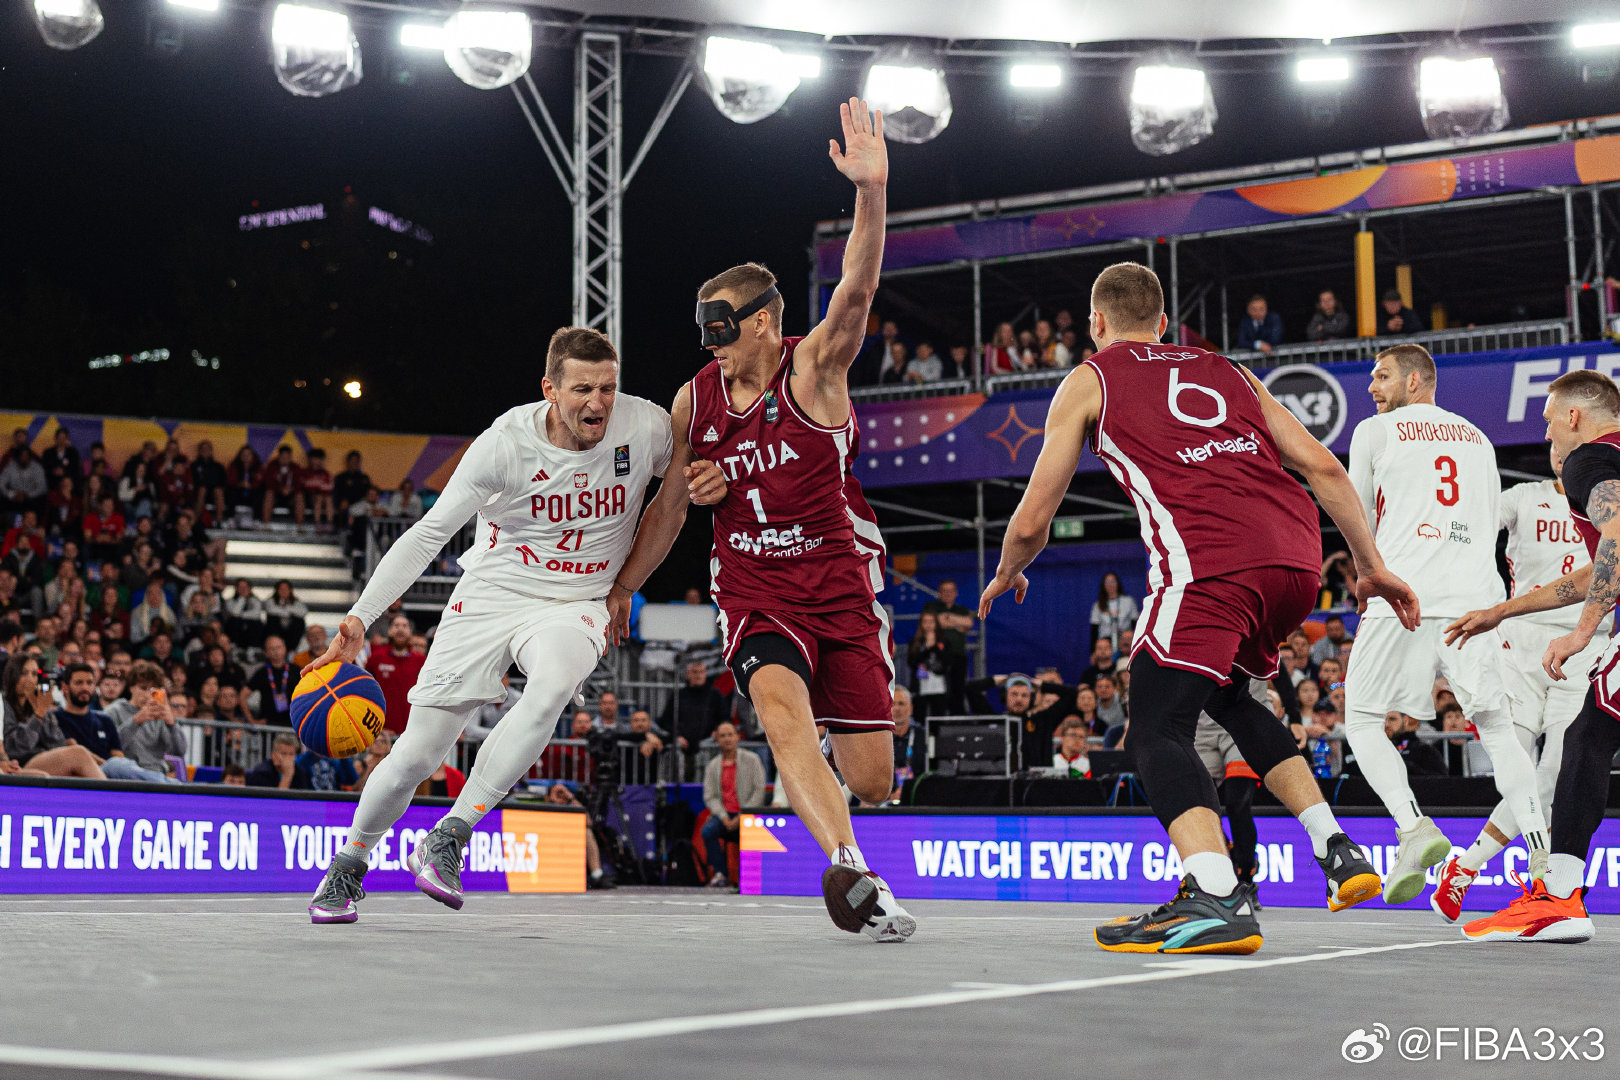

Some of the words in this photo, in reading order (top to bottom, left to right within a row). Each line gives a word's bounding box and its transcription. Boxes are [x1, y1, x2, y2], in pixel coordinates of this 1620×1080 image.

[1167, 367, 1228, 428] 6
[1396, 421, 1482, 445] SOKOŁOWSKI
[1434, 455, 1460, 507] 3
[530, 483, 626, 523] POLSKA
[746, 488, 768, 524] 1
[1449, 531, 1472, 545] Pekao
[1451, 520, 1469, 532] Bank
[556, 528, 585, 552] 21
[805, 536, 824, 552] Bar
[545, 558, 611, 575] ORLEN
[1561, 554, 1575, 576] 8
[21, 814, 126, 870] EVERY
[132, 818, 213, 871] GAME
[218, 821, 259, 871] ON
[911, 839, 1023, 880] WATCH
[1030, 841, 1134, 881] EVERY
[1141, 841, 1187, 882] GA
